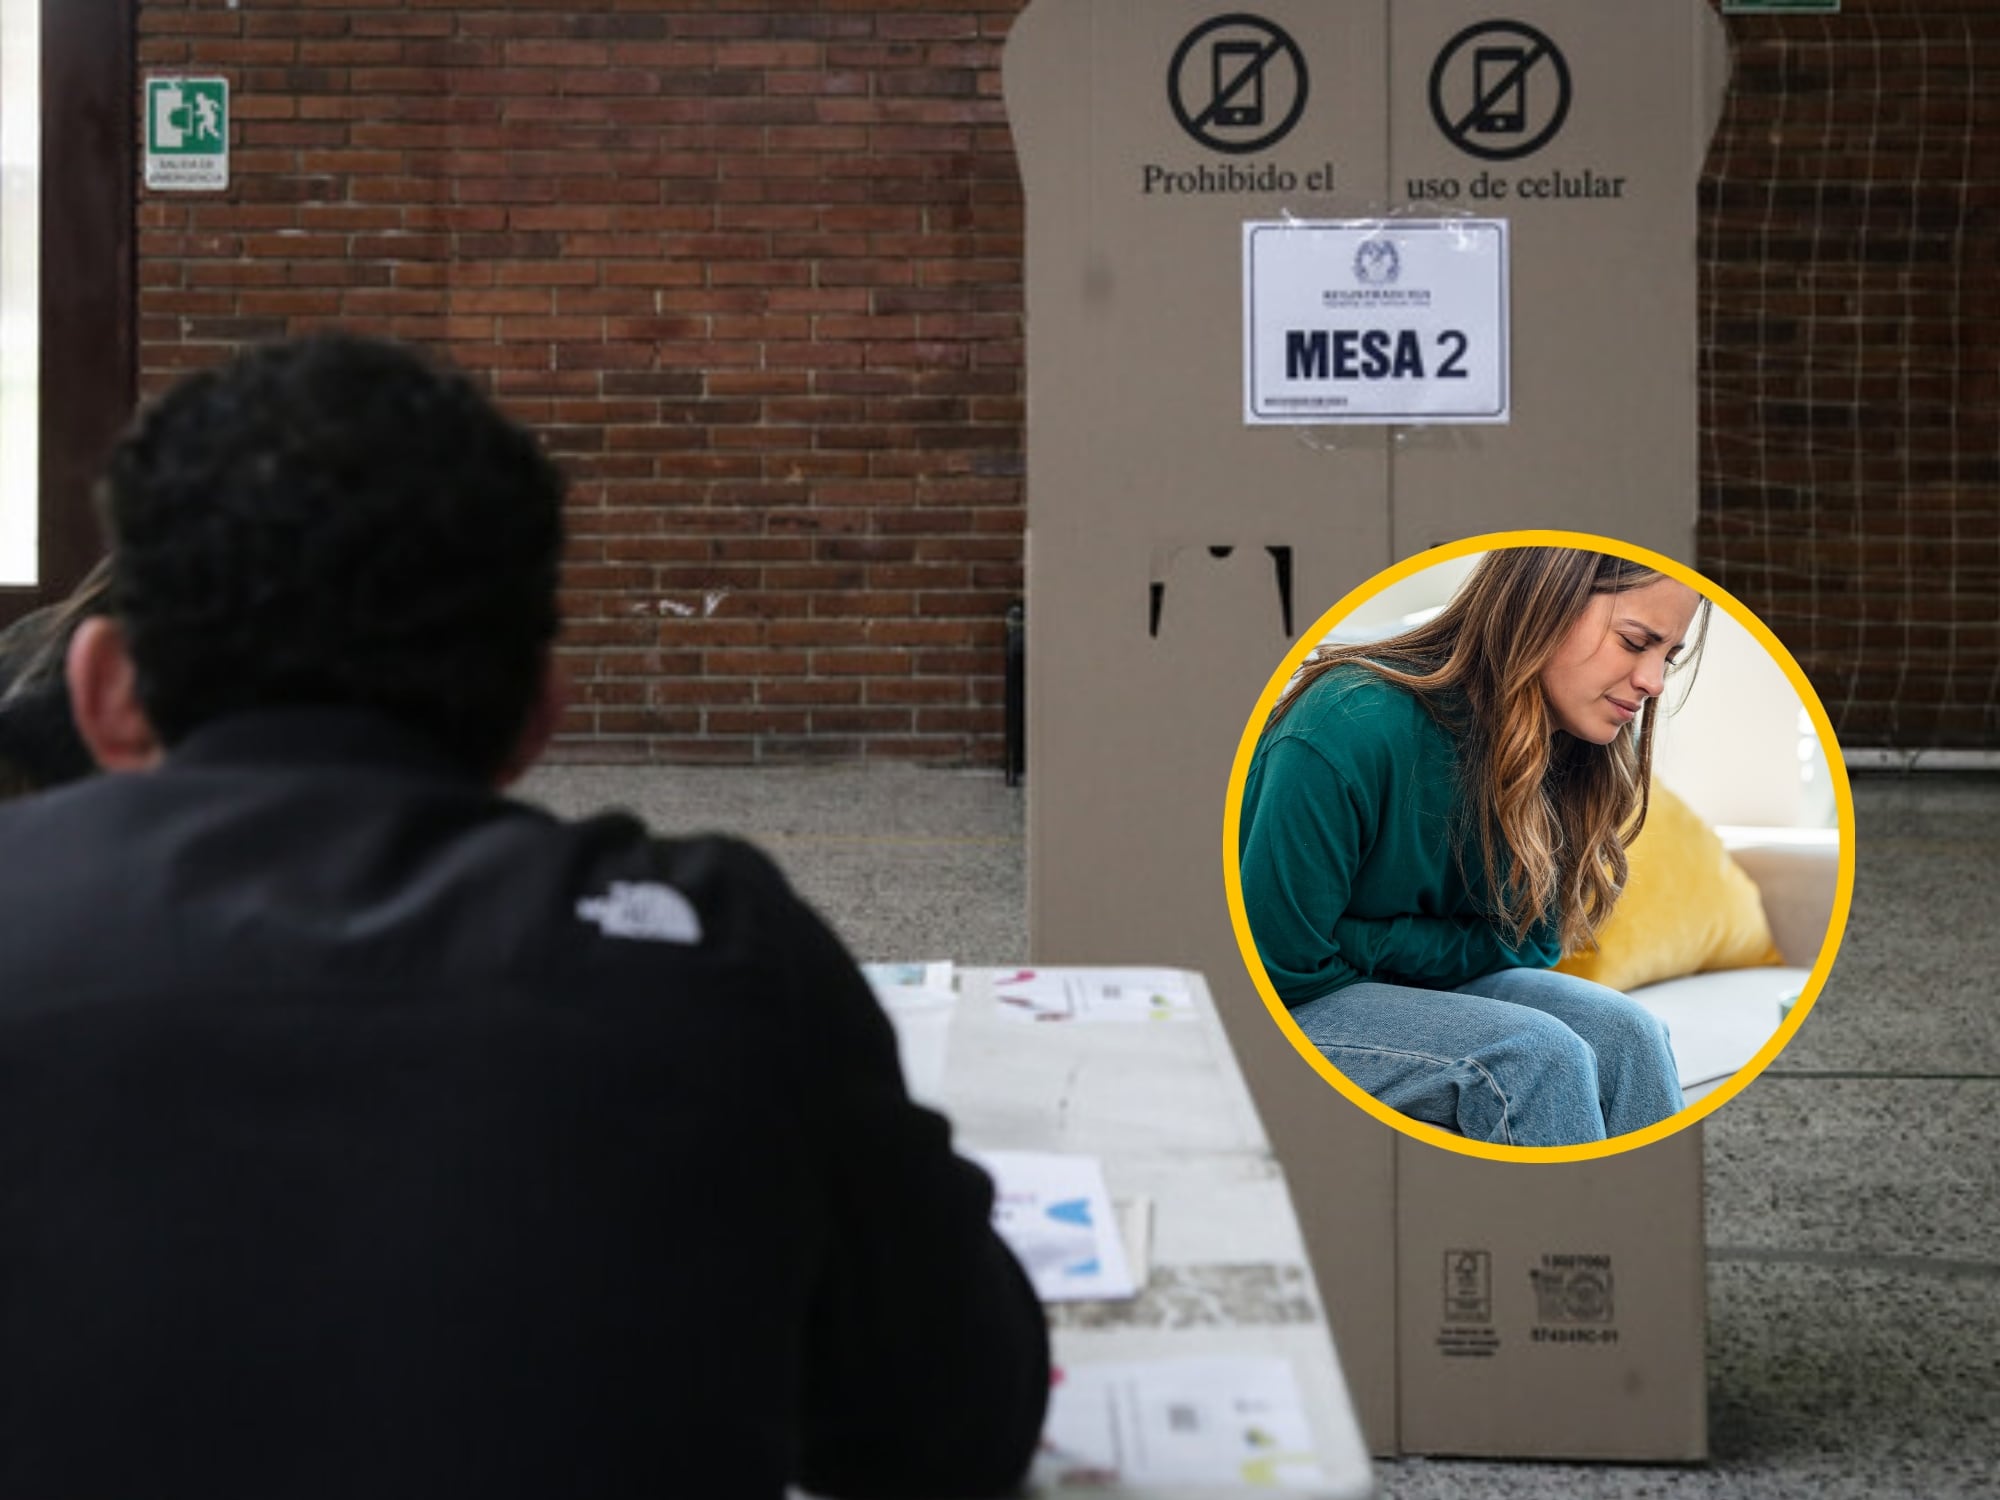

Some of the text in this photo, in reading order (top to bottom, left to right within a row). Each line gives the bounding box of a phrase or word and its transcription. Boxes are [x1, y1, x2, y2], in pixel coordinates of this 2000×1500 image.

[1143, 163, 1334, 195] Prohibido el
[1406, 168, 1626, 200] uso de celular
[1285, 329, 1468, 380] MESA 2
